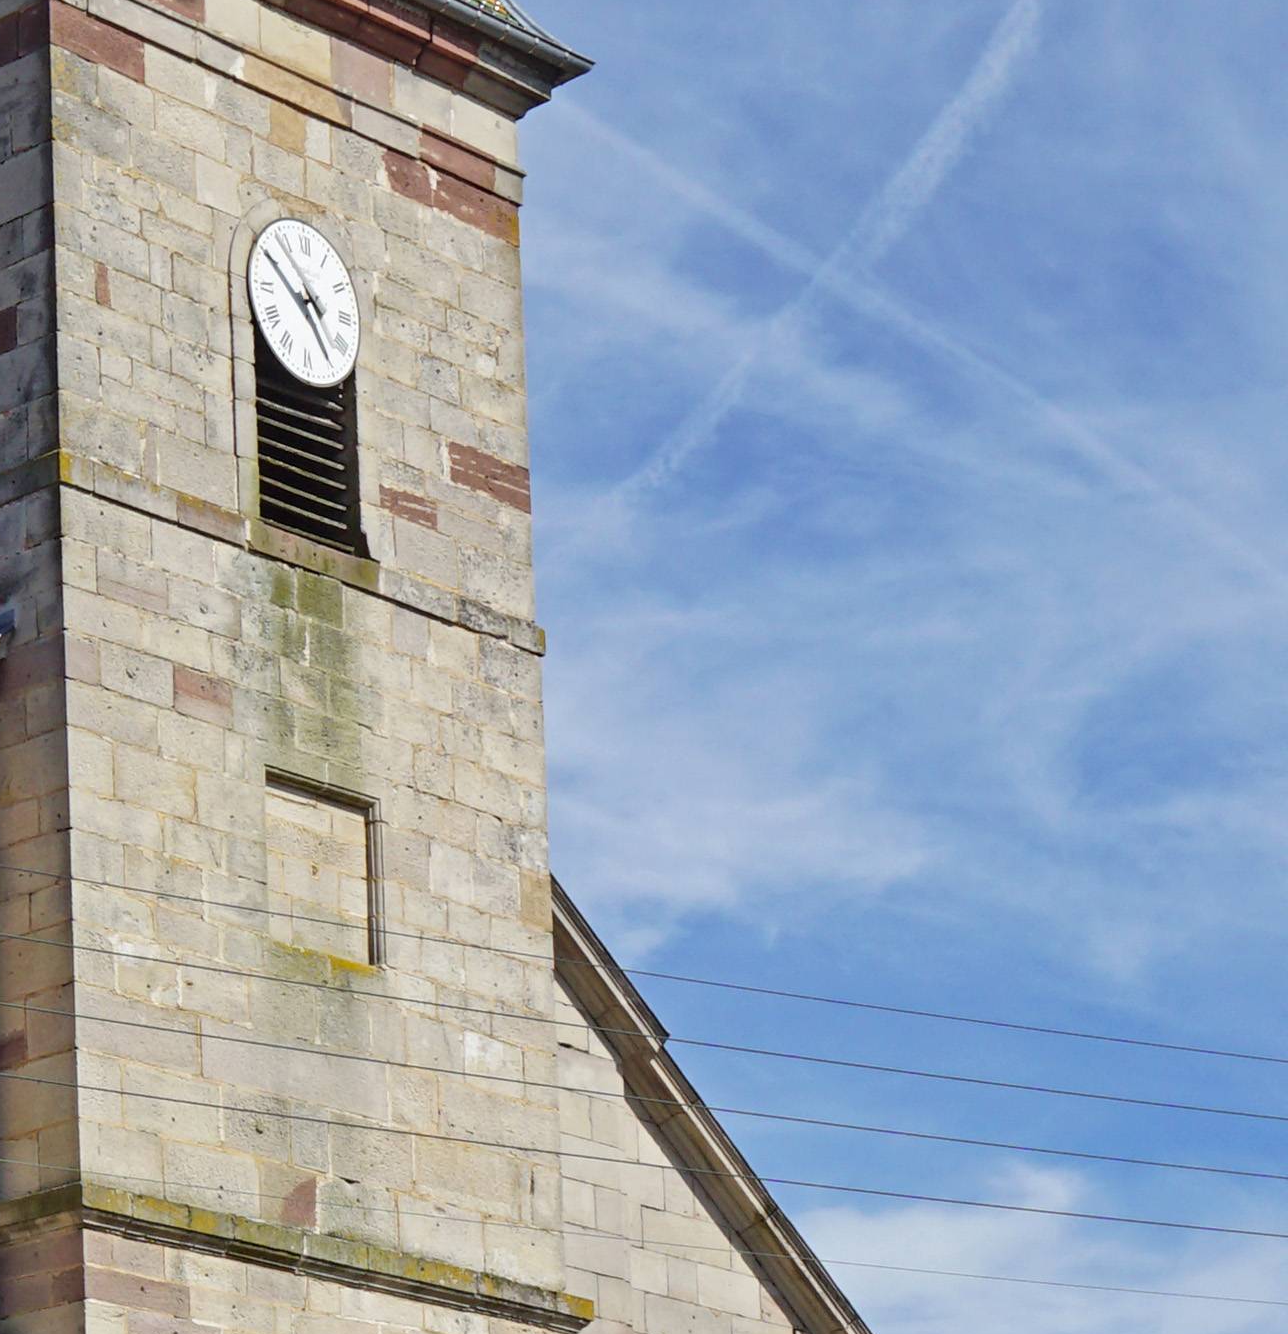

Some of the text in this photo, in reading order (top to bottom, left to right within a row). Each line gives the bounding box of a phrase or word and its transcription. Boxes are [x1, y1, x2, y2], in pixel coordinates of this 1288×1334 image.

[320, 254, 327, 268] I
[333, 282, 345, 294] II
[338, 310, 351, 326] III
